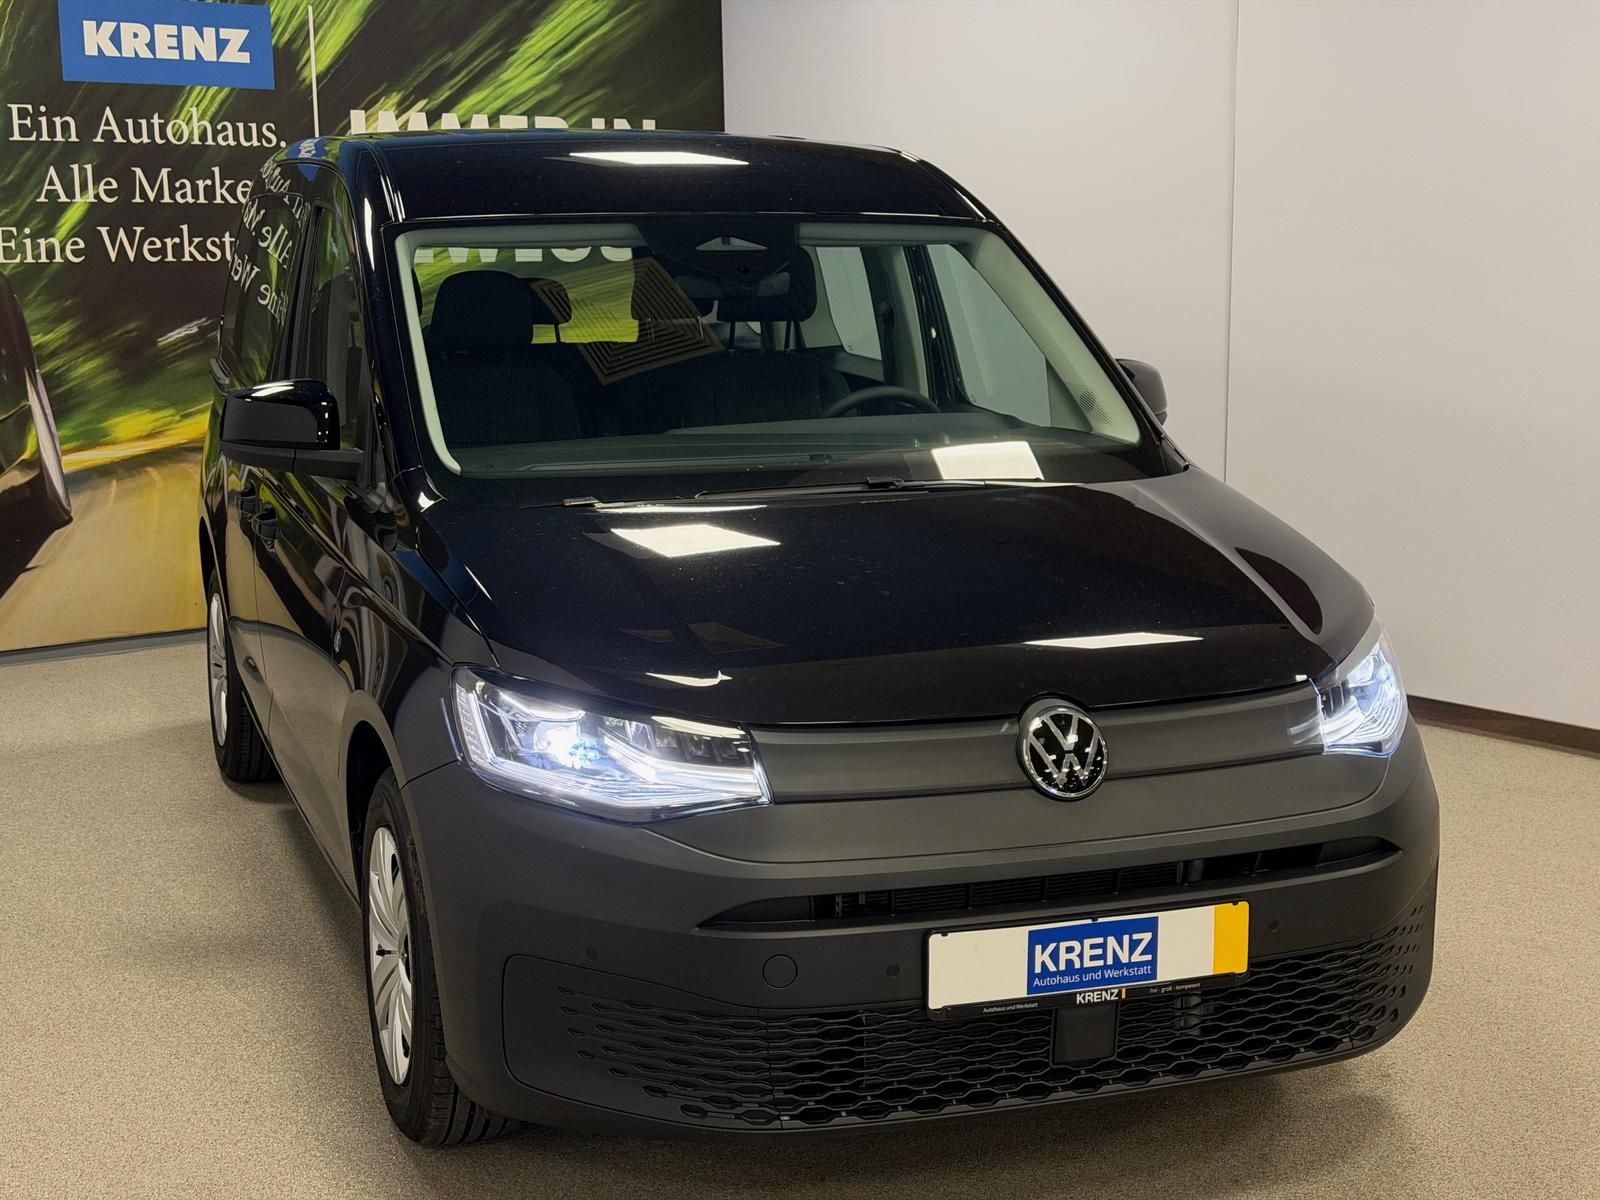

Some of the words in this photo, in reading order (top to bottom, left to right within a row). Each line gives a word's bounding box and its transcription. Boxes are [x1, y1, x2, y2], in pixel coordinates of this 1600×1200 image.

[82, 20, 251, 64] KRENZ
[7, 103, 79, 142] Ein
[92, 106, 287, 148] Autohaus.
[36, 163, 119, 203] Alle
[0, 226, 86, 264] Eine
[1033, 932, 1153, 973] KRENZ
[1033, 974, 1081, 987] Autohaus
[1082, 970, 1102, 981] und
[1104, 965, 1152, 979] Werkstatt
[1076, 989, 1119, 1005] KRENZ
